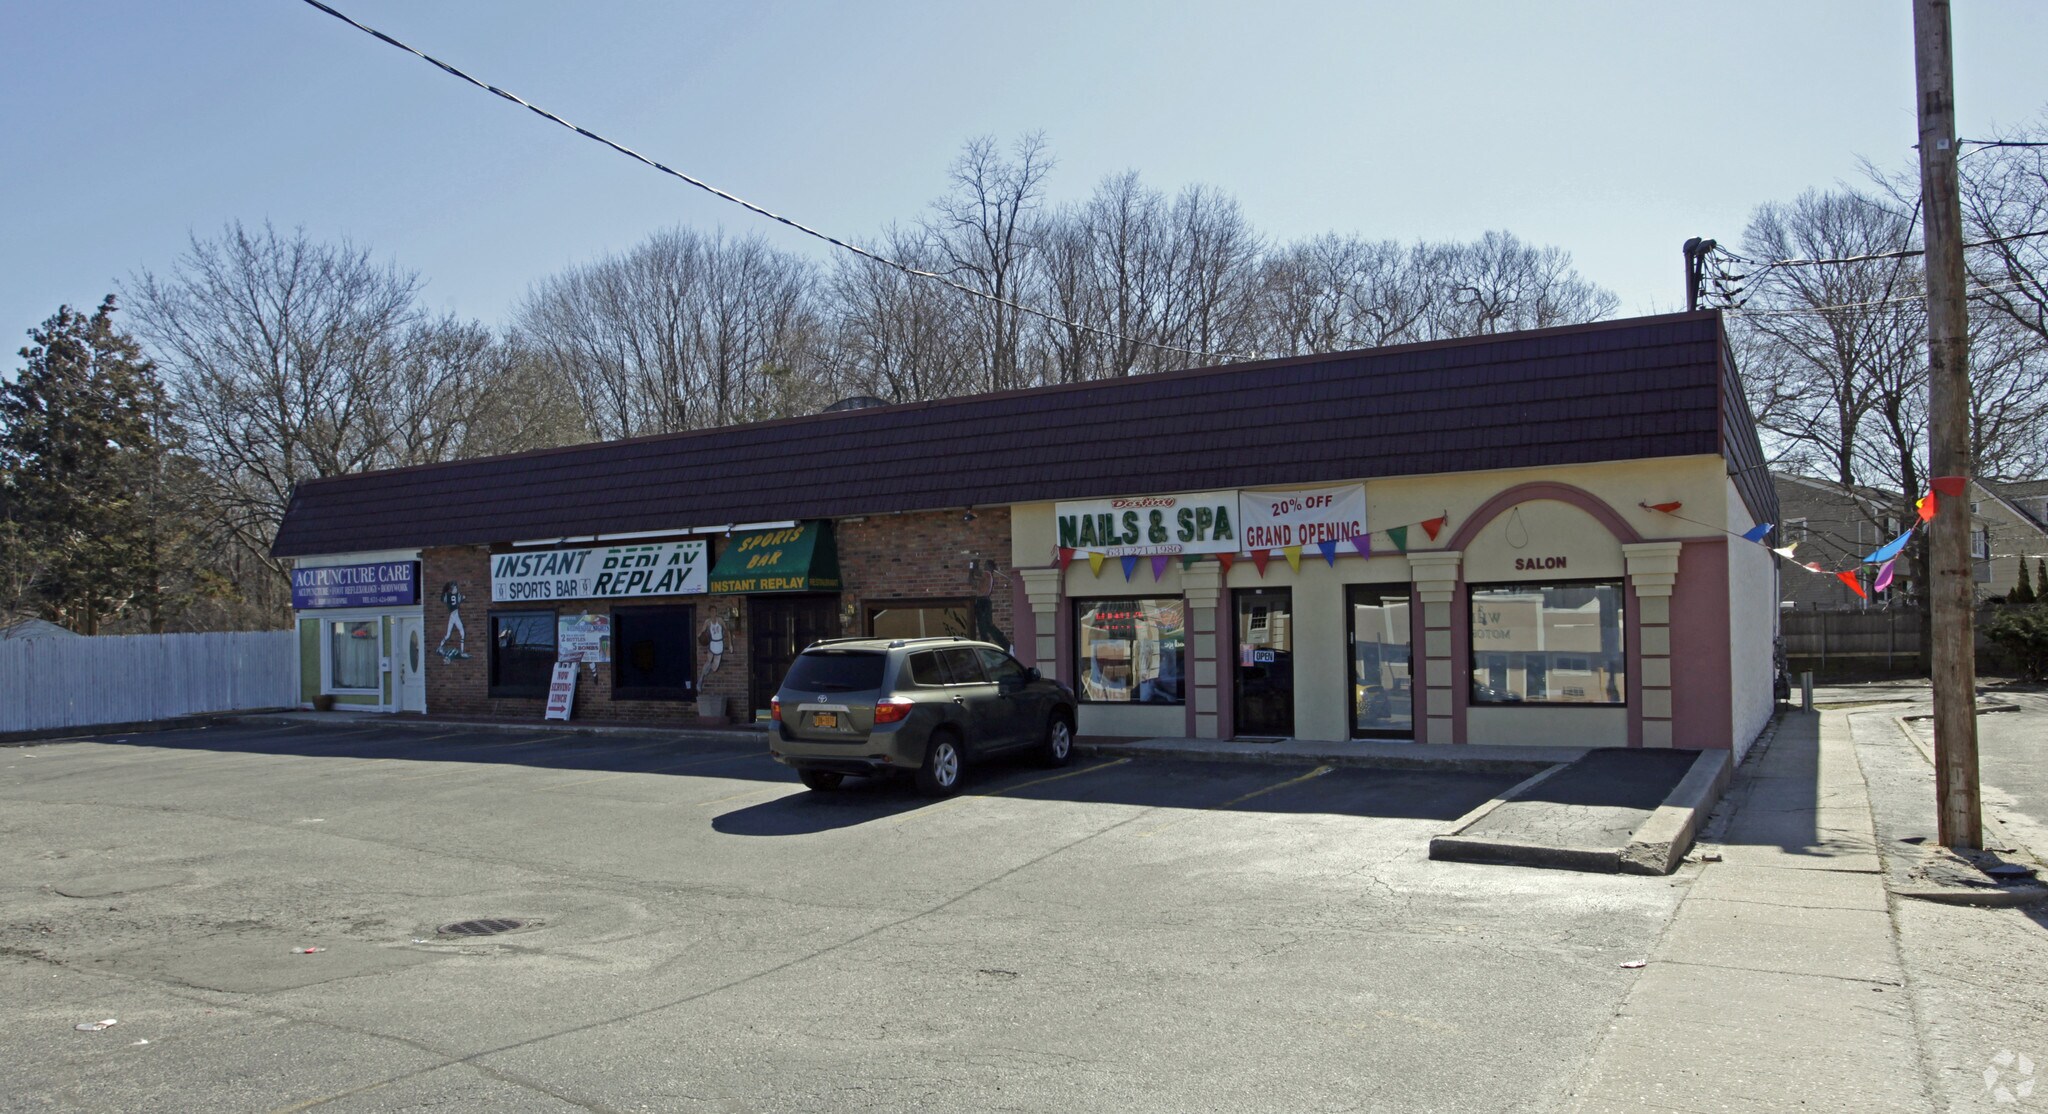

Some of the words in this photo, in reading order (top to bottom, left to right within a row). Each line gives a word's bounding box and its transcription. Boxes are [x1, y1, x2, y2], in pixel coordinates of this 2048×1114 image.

[1112, 498, 1175, 508] Destiny
[1272, 497, 1302, 517] 20%
[1305, 495, 1333, 508] OFF
[1058, 511, 1140, 548] NAILS
[1148, 509, 1168, 543] &
[1177, 506, 1233, 543] SPA
[1246, 525, 1291, 547] GRAND
[1298, 521, 1360, 545] OPENING
[737, 526, 804, 553] SPORTS
[494, 550, 592, 578] INSTANT
[746, 550, 783, 569] BAR
[1515, 556, 1567, 570] SALON
[296, 566, 376, 587] ACUPUNCTURE
[378, 564, 411, 582] CARE
[592, 567, 692, 596] REPLAY
[710, 580, 756, 593] INSTANT
[760, 577, 805, 590] REPLAY
[345, 584, 377, 595] REFLEXOLOGY
[380, 583, 408, 593] BODYWORK
[509, 581, 551, 599] SPORTS
[556, 579, 578, 597] BAR
[1256, 651, 1273, 660] OPEN
[557, 671, 569, 680] NOW
[551, 682, 571, 692] SERVING
[550, 694, 568, 703] LUNCH
